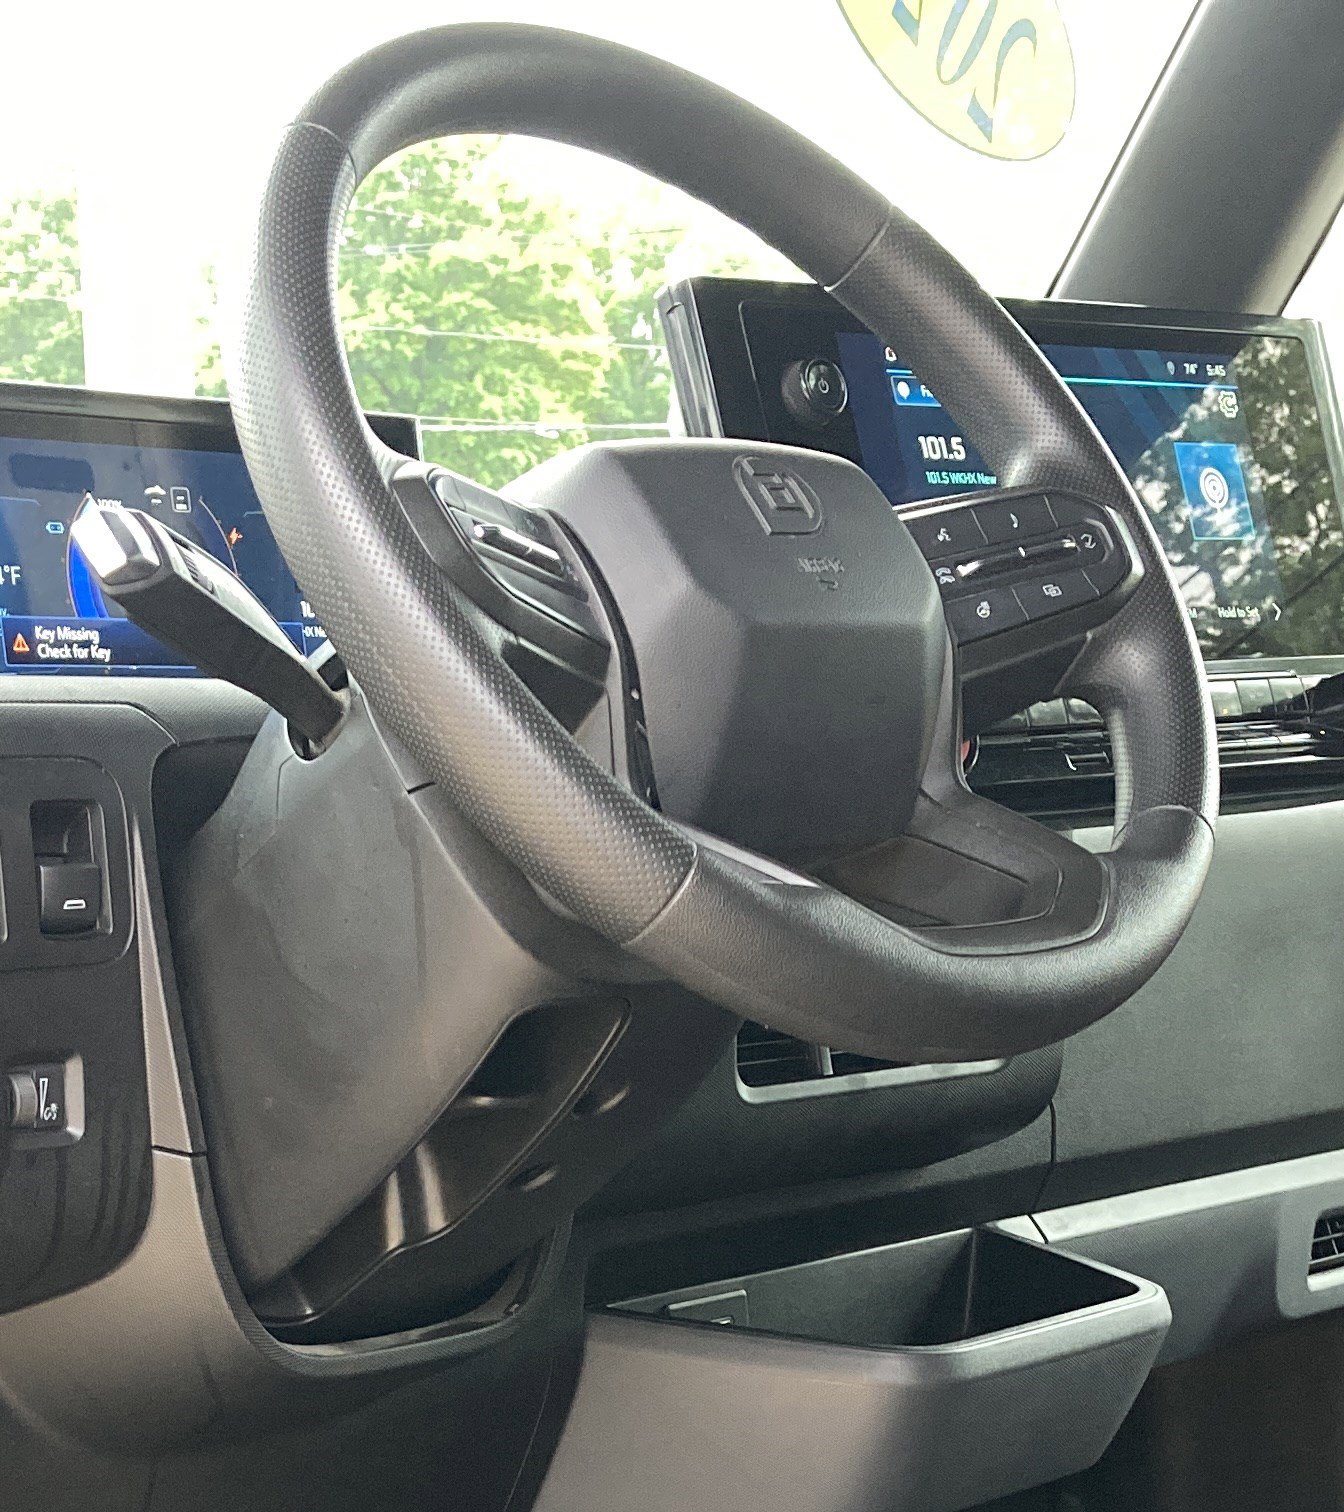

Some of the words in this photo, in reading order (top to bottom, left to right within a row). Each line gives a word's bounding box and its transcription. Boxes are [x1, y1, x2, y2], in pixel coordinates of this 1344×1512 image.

[1206, 363, 1227, 377] 5:45
[917, 435, 966, 460] 101.5
[925, 470, 949, 484] 101.5
[1217, 606, 1237, 618] Hold
[34, 625, 55, 644] Key
[56, 625, 100, 645] Missing
[36, 642, 72, 659] Check
[72, 643, 89, 659] for
[90, 644, 111, 663] Key
